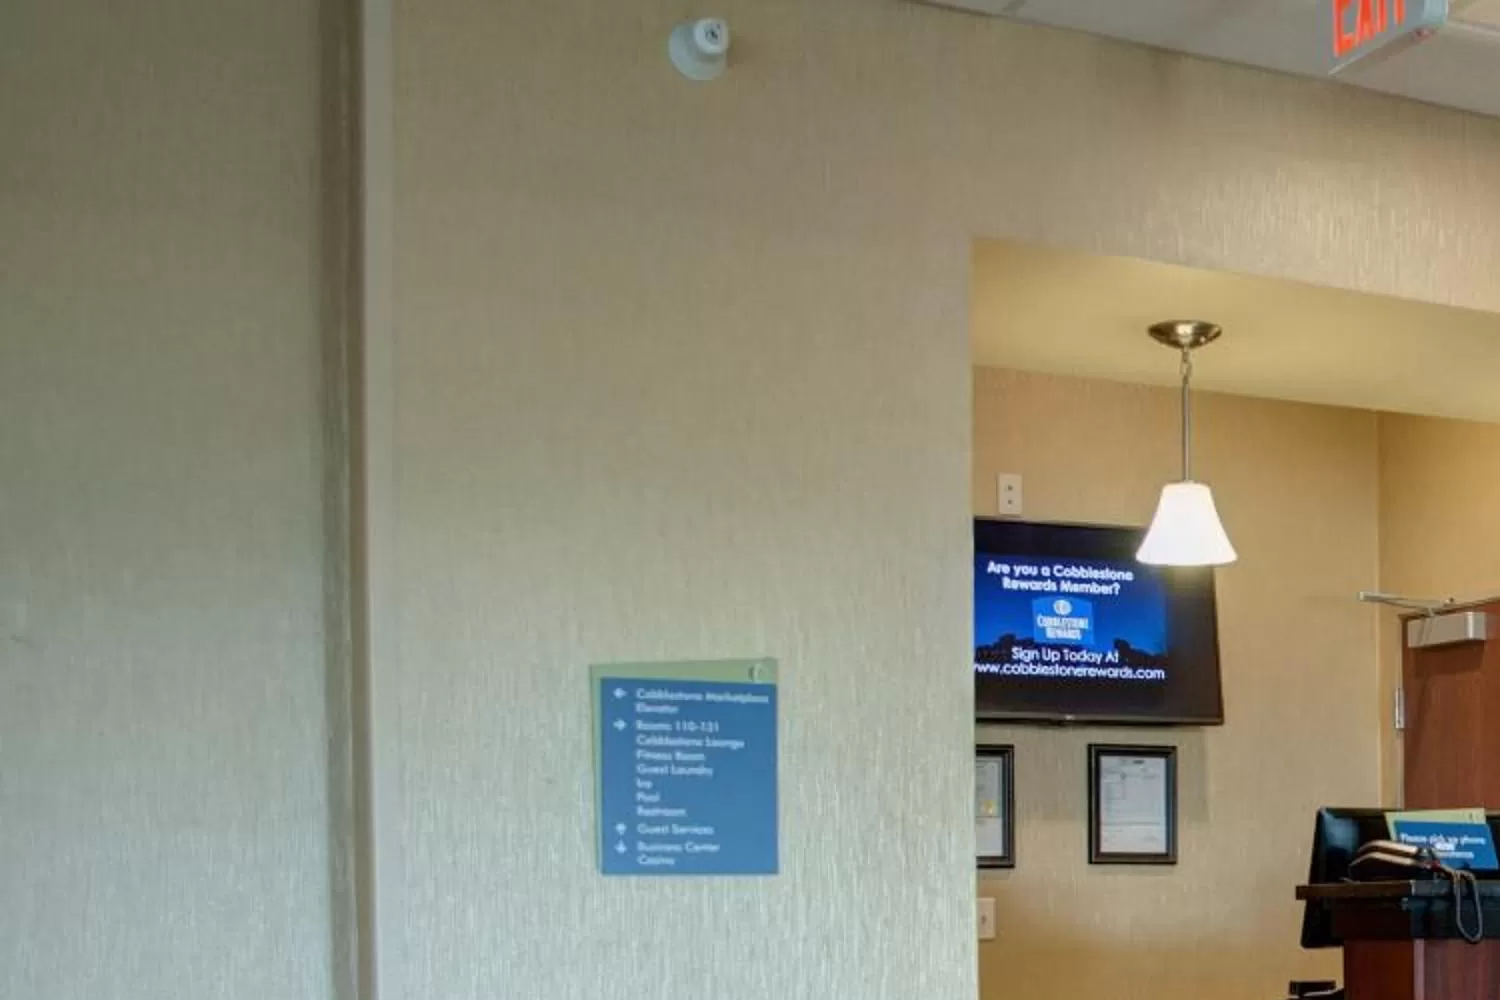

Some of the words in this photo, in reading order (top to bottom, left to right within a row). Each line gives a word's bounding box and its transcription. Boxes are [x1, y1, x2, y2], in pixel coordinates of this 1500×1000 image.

[987, 560, 1010, 573] Are
[1013, 563, 1038, 577] you
[1041, 566, 1050, 577] a
[1053, 565, 1135, 581] Cobblestone
[1002, 576, 1057, 592] Rewards
[1060, 580, 1121, 595] Member?
[1011, 647, 1037, 662] Sign
[1041, 648, 1061, 663] Up
[1064, 650, 1103, 665] Today
[1105, 651, 1119, 663] At
[636, 687, 703, 701] Cobblestone
[636, 734, 703, 746] Cobblestone
[636, 763, 669, 775] Guest
[637, 823, 669, 834] Guest
[672, 823, 715, 836] Services
[684, 841, 720, 853] Center
